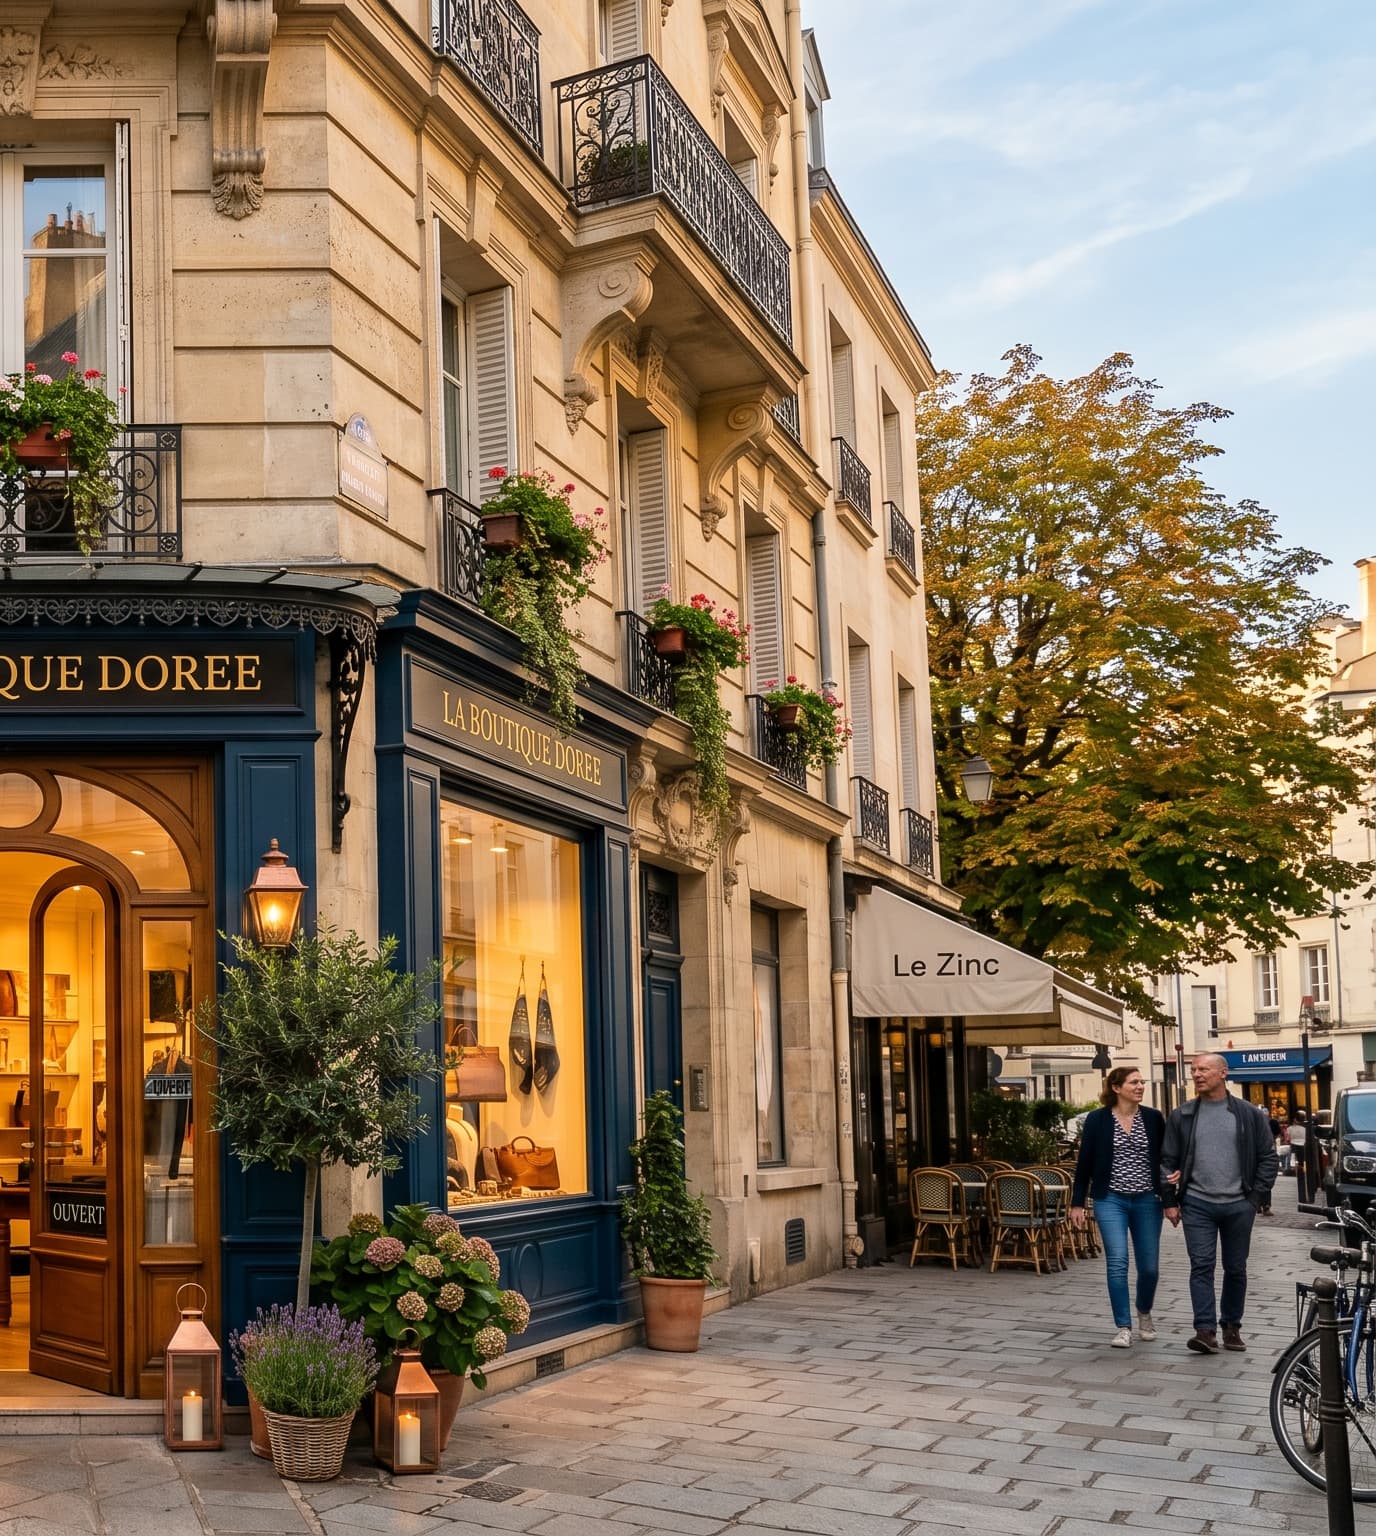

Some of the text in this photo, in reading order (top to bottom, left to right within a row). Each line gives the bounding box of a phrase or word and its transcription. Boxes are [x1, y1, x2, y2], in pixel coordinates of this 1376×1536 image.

[98, 655, 262, 691] DOREE
[442, 691, 601, 786] LA BOUTIQUE DOREE
[894, 952, 1000, 977] Le Zinc
[53, 1202, 105, 1225] OUVERT
